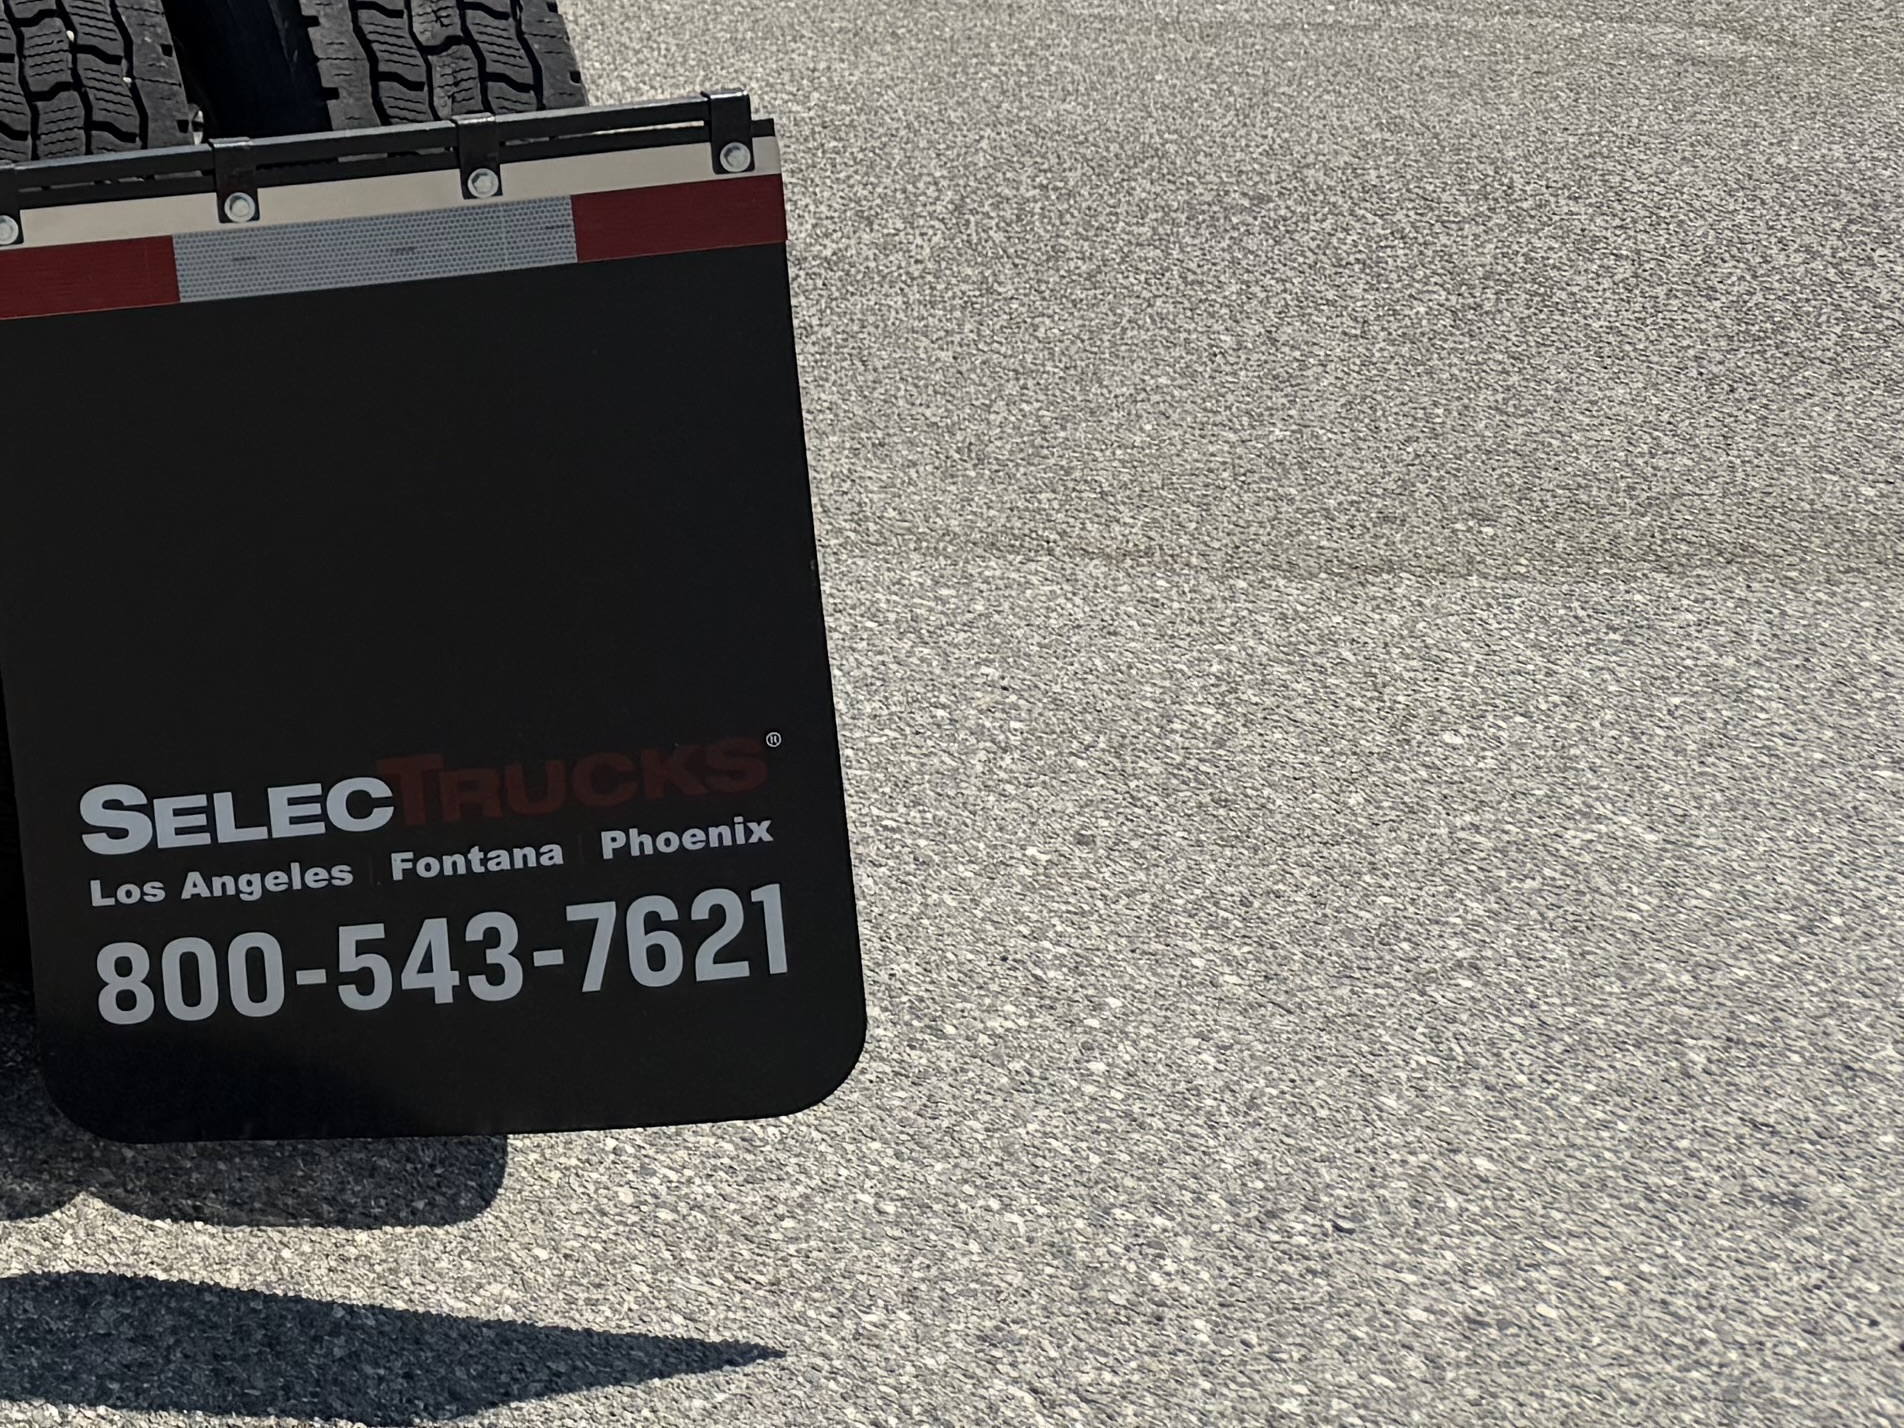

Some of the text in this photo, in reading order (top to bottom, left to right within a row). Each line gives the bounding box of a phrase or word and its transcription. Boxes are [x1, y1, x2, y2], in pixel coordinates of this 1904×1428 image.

[90, 816, 774, 907] Los Angeles Fontana Phoenix
[95, 883, 789, 1026] 800-543-7621
